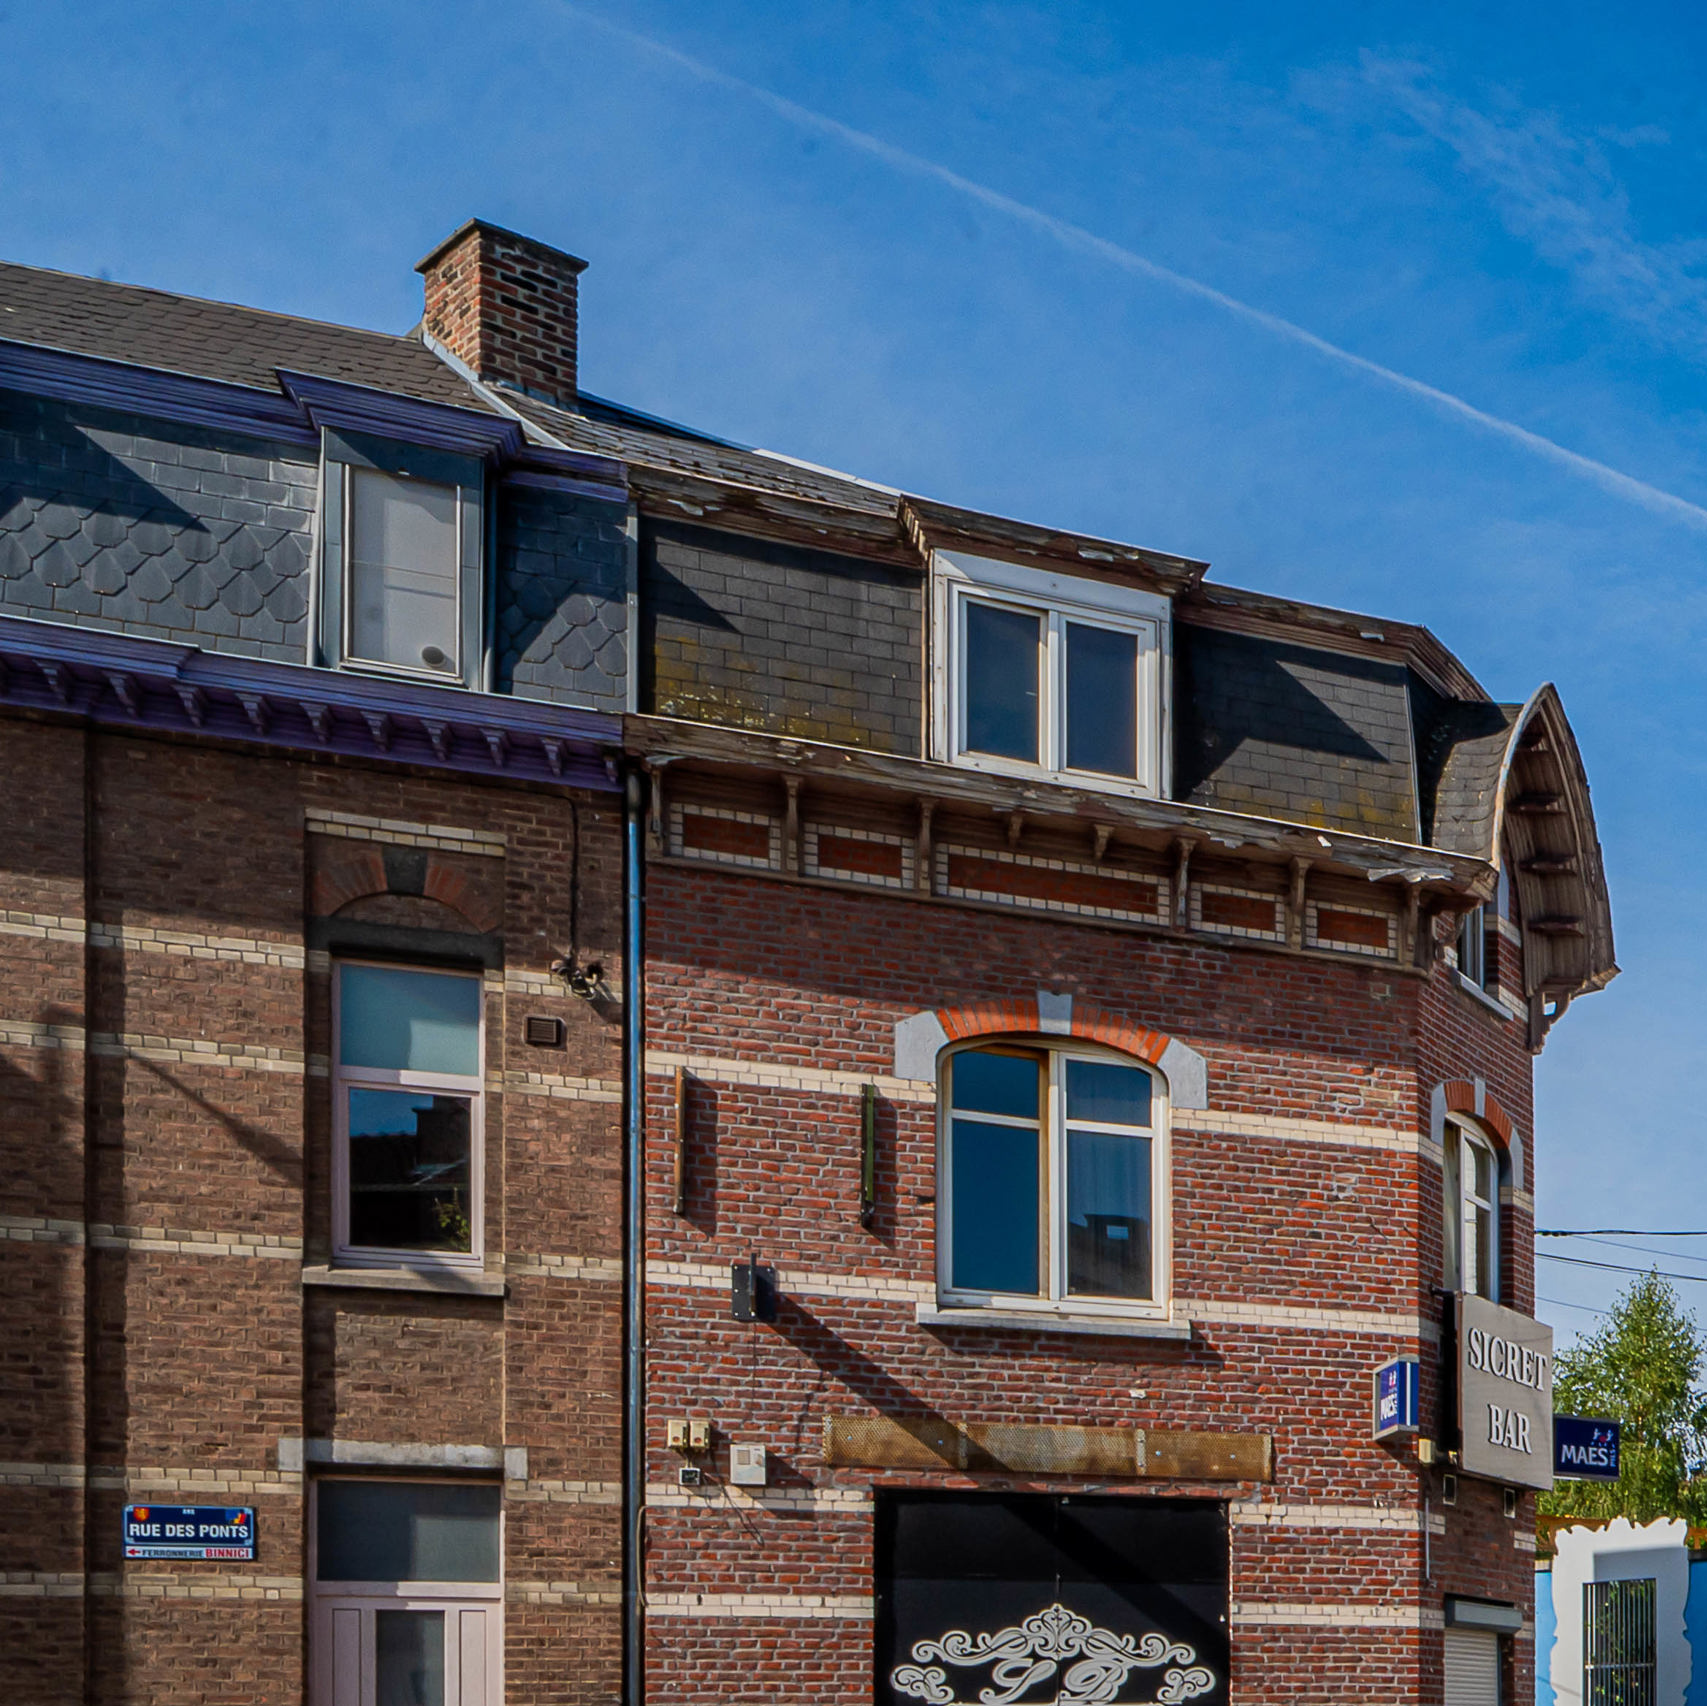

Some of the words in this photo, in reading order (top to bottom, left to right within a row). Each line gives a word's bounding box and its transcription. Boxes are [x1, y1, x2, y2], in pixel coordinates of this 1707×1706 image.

[1468, 1327, 1548, 1392] SICRET
[1487, 1403, 1532, 1454] BAR
[1561, 1444, 1608, 1466] MAES
[129, 1524, 161, 1536] RUE
[165, 1525, 195, 1537] DES
[199, 1525, 248, 1538] PONTS
[205, 1548, 249, 1558] BINNICI
